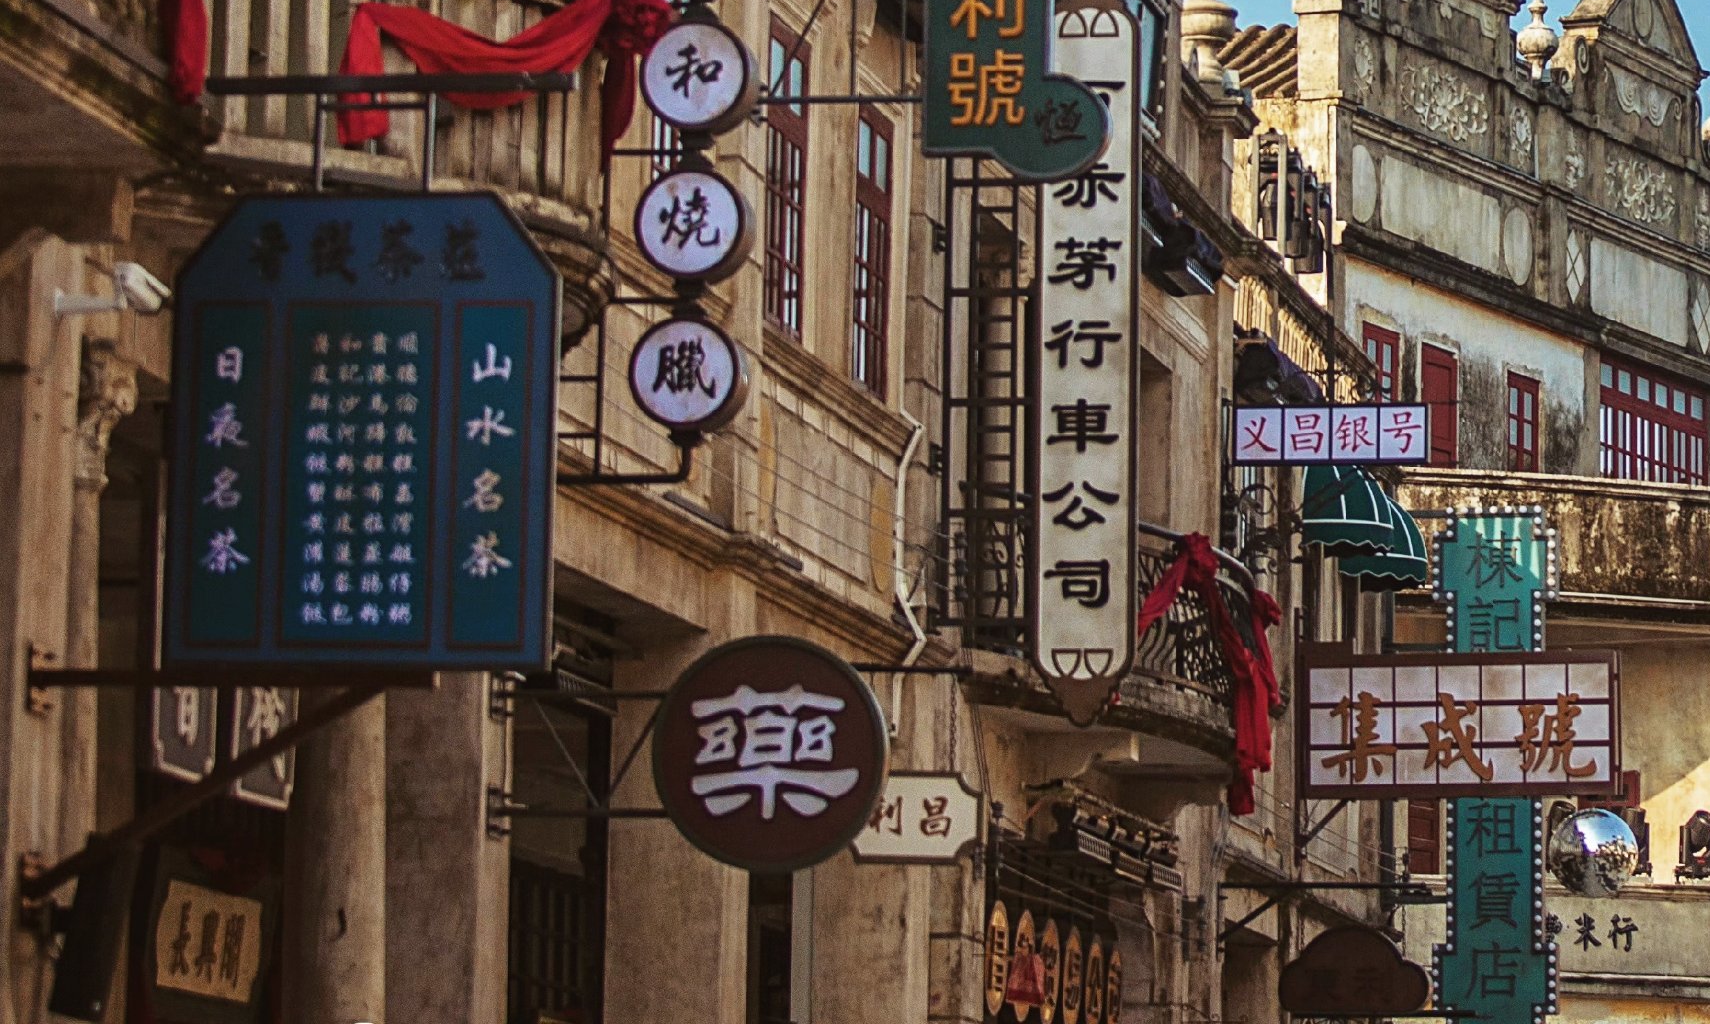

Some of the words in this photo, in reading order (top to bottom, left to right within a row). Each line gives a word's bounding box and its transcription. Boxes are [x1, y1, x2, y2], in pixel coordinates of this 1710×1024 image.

[1043, 80, 1122, 608] 赤茅行車公司
[1240, 410, 1423, 454] 义昌银号
[201, 344, 252, 575] 日夜名茶
[462, 342, 514, 580] 山水名茶
[690, 684, 860, 820] 藥
[1322, 692, 1597, 783] 集成號
